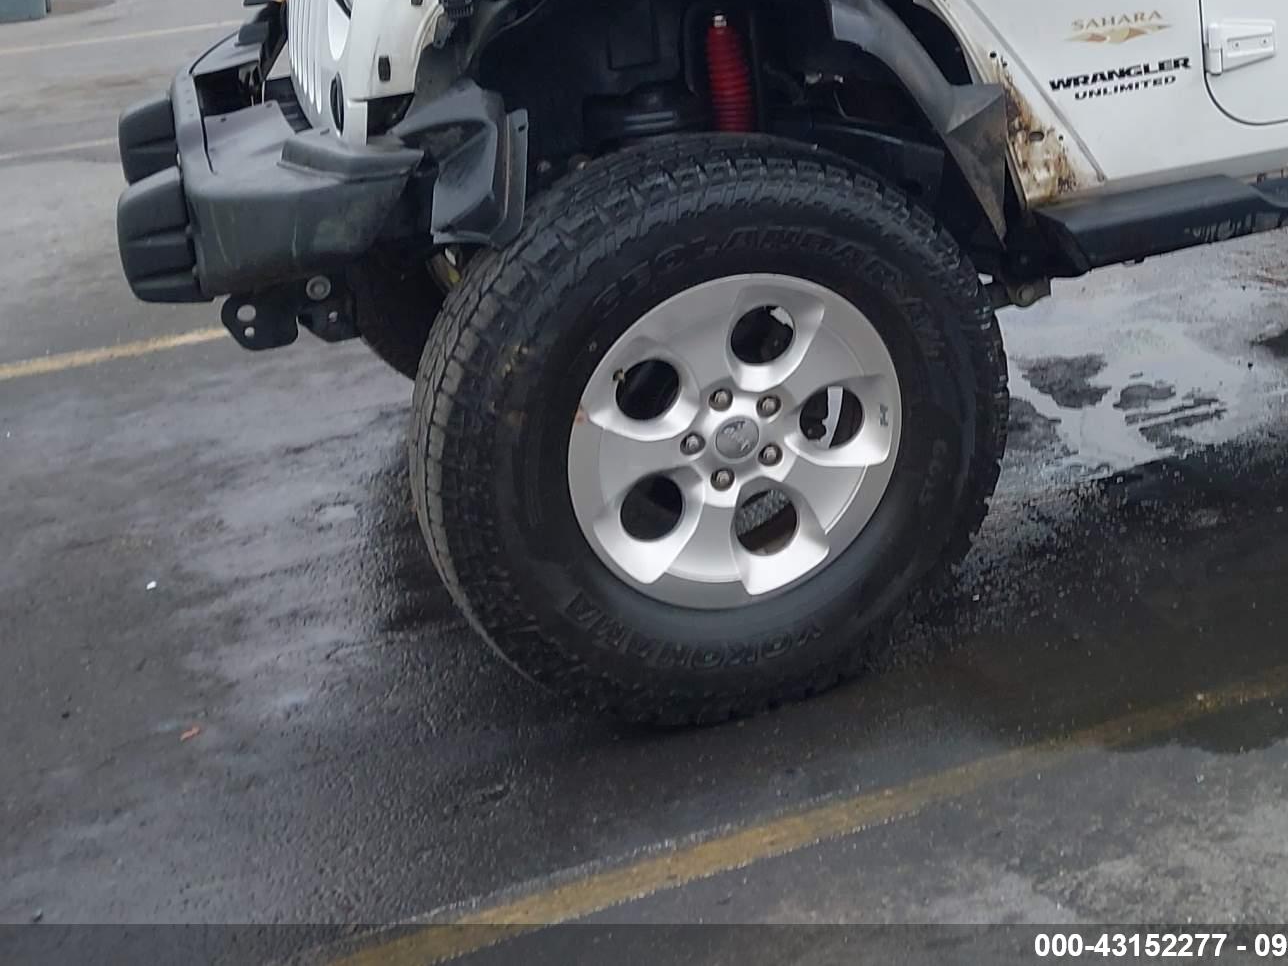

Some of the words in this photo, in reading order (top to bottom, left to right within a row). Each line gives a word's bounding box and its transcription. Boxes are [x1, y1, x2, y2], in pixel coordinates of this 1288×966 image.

[1071, 10, 1163, 31] SAHARA
[1049, 56, 1191, 91] WRANGLER
[1074, 75, 1176, 100] UNLIMITED
